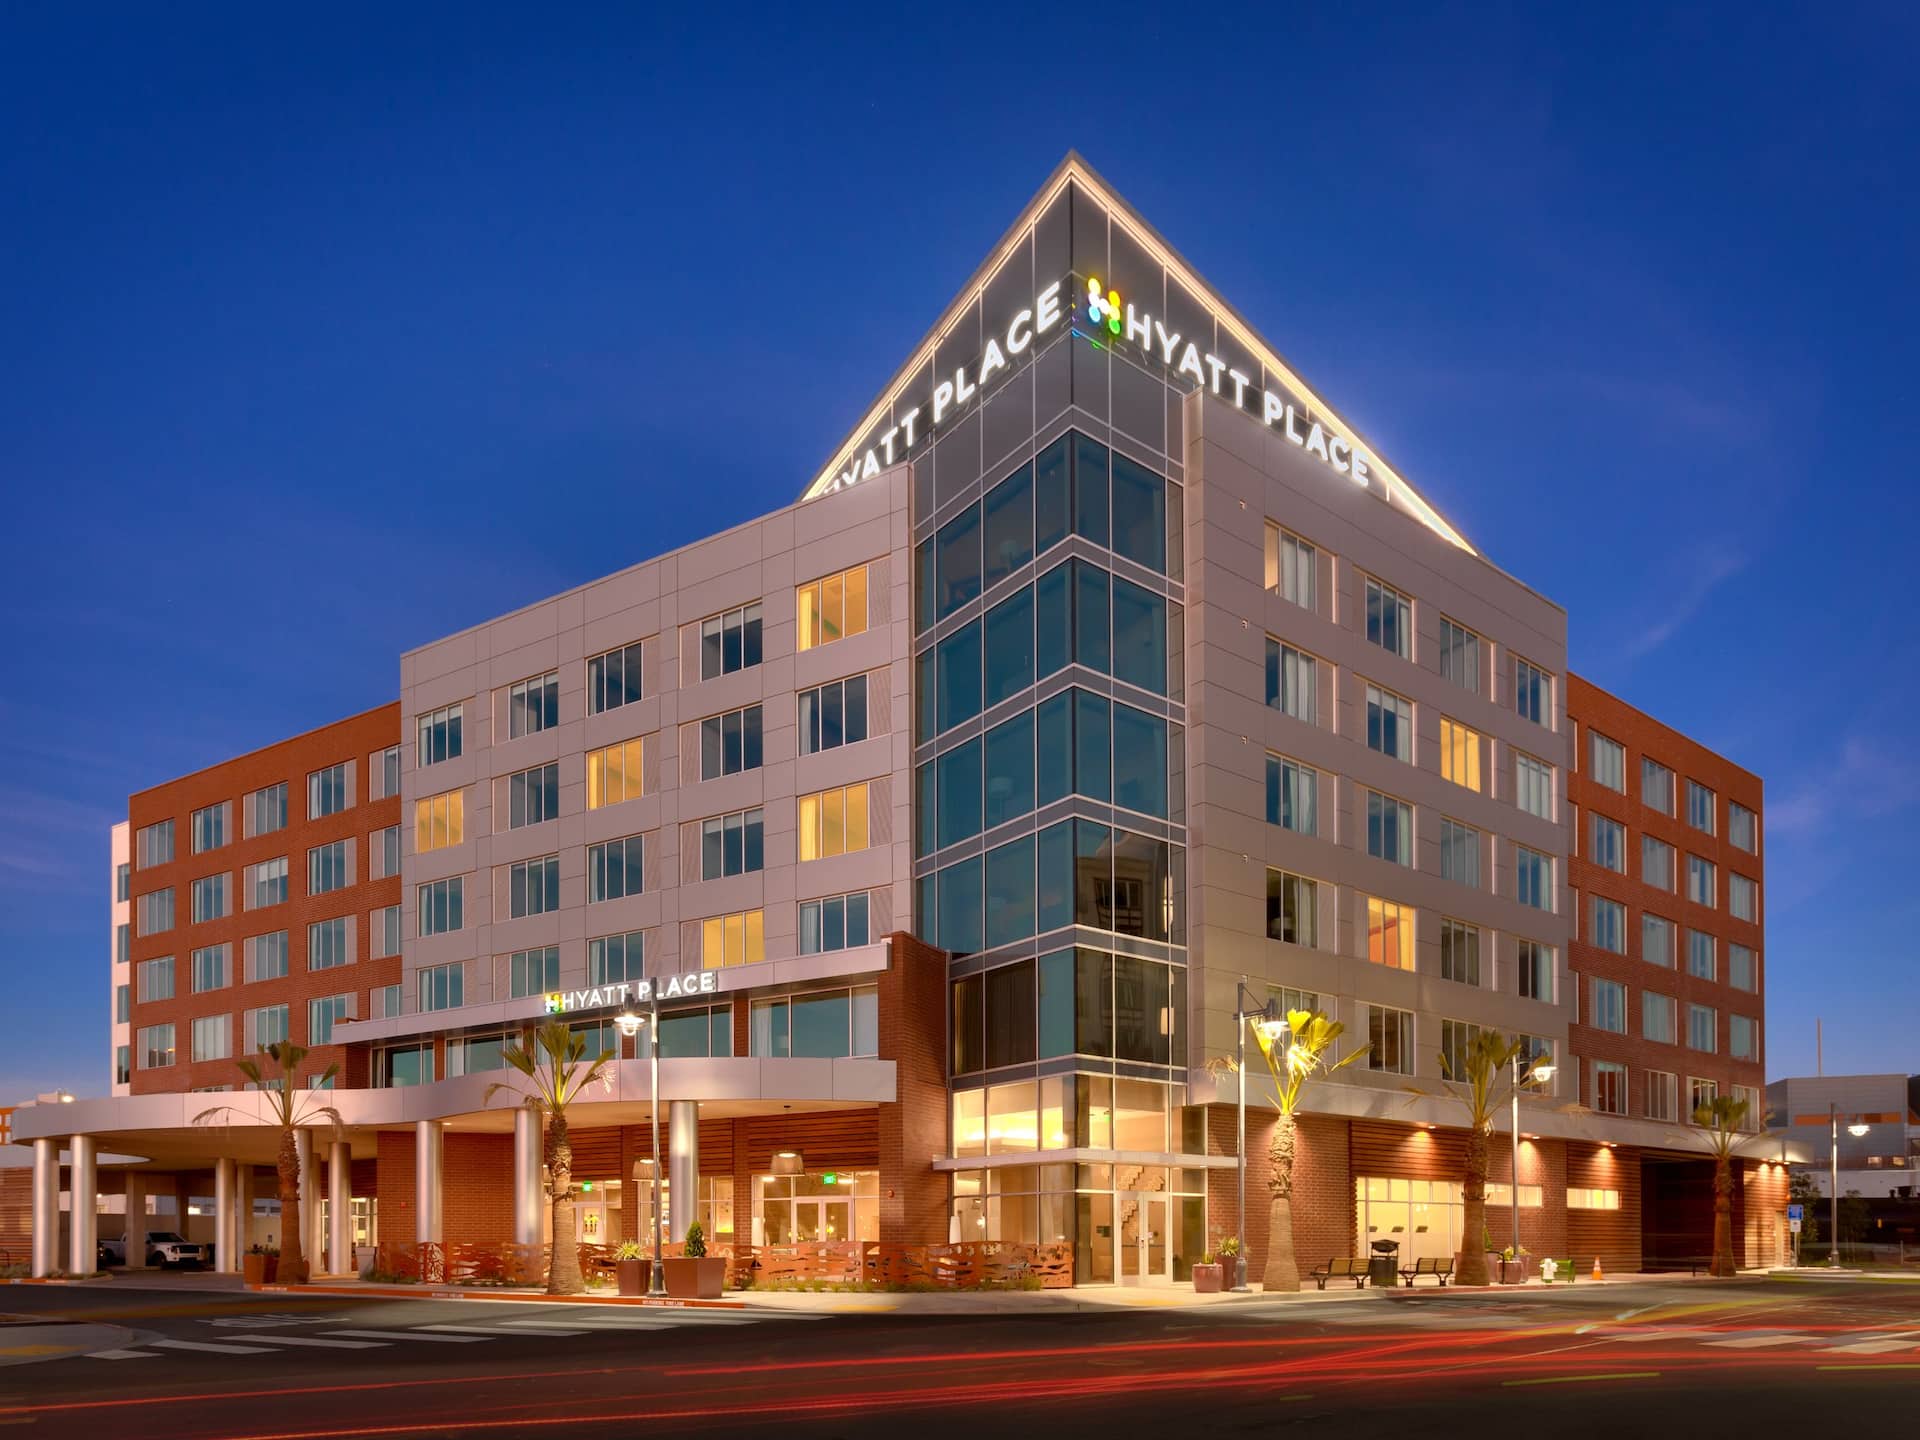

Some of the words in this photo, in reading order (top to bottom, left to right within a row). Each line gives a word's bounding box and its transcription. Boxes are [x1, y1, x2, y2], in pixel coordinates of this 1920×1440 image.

[823, 407, 920, 494] YATT
[933, 281, 1061, 424] PLACE
[1126, 303, 1250, 408] HYATT
[1264, 390, 1369, 486] PLACE
[562, 984, 630, 1009] HYATT
